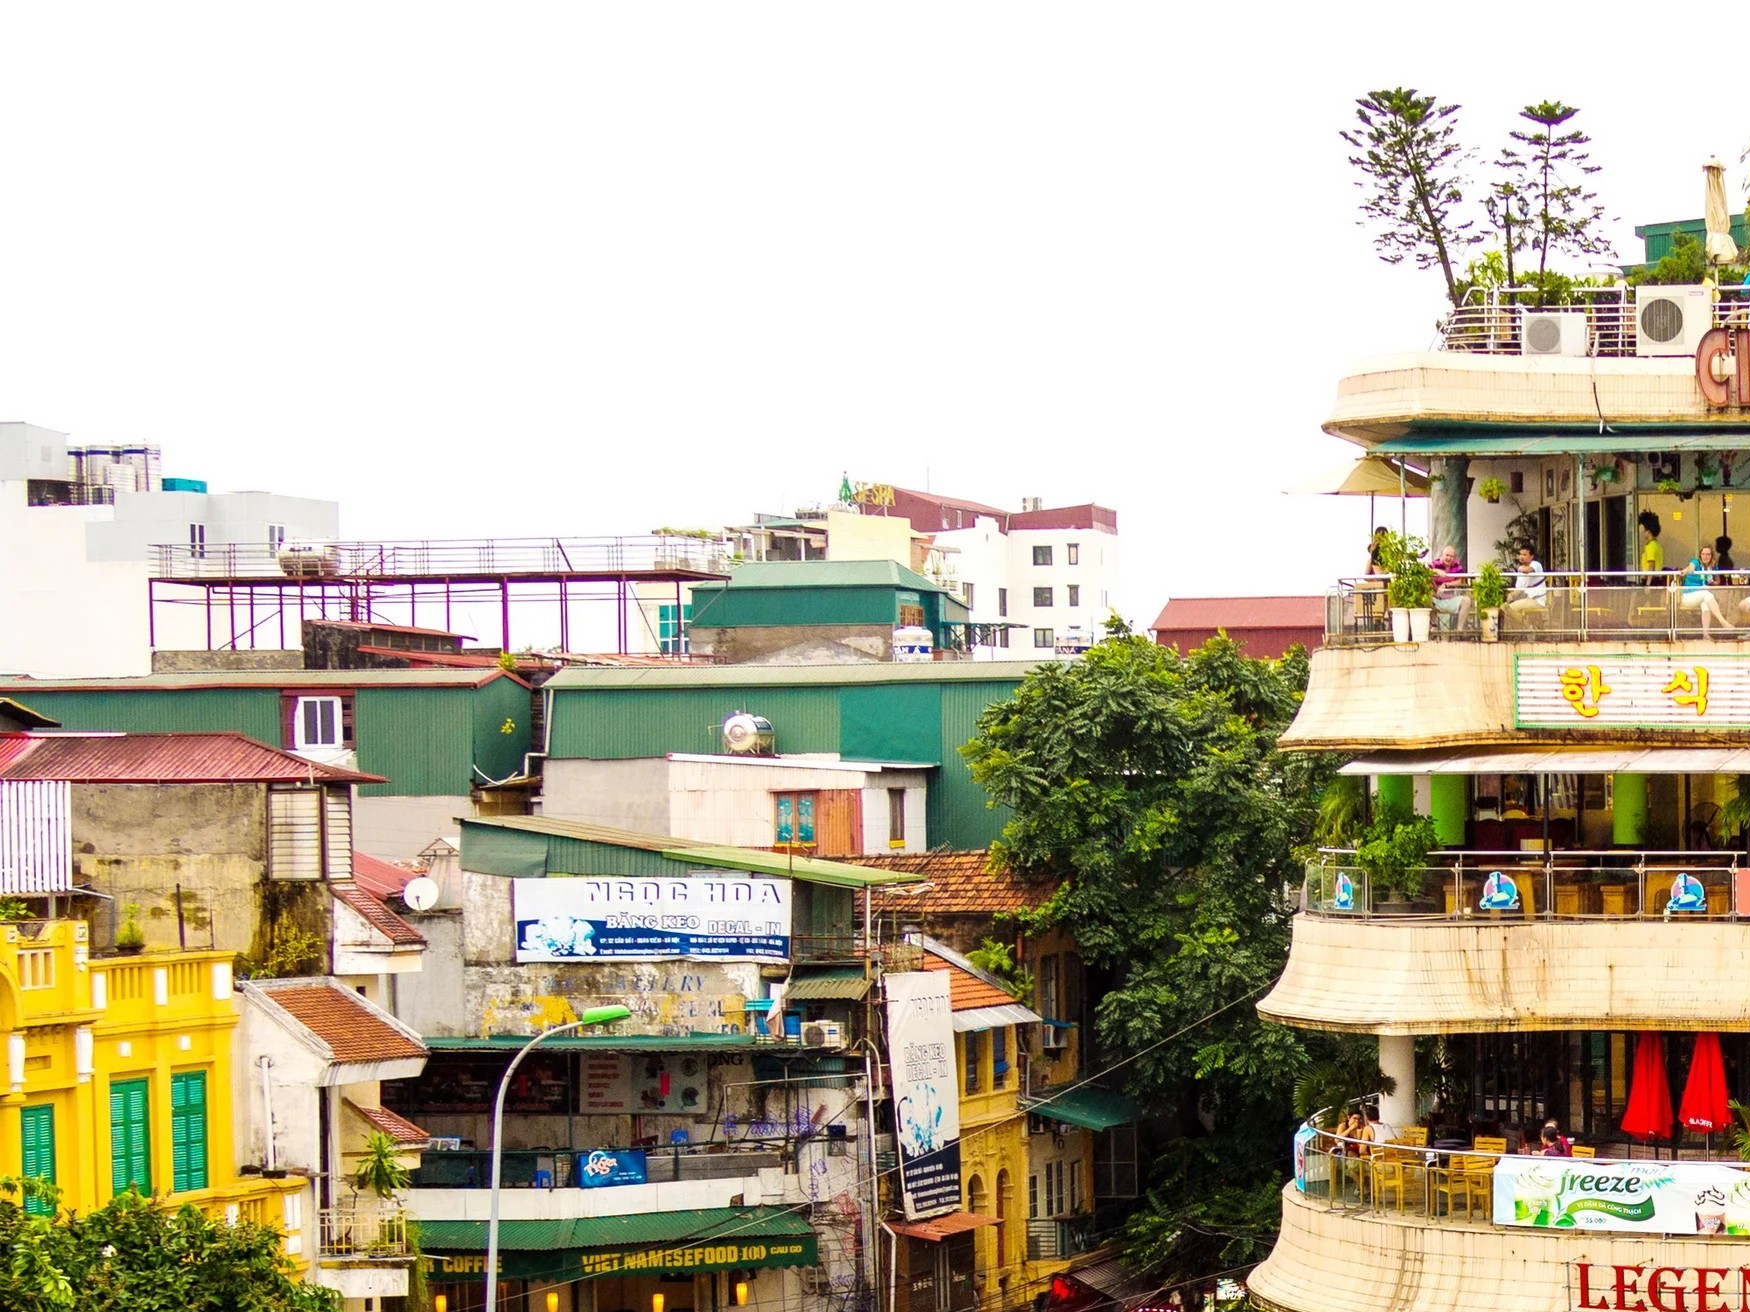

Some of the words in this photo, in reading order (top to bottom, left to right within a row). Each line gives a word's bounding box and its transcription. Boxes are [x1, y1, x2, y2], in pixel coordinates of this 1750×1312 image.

[606, 912, 659, 930] BĂNG
[661, 914, 700, 930] KEO
[708, 919, 752, 936] DECAL
[764, 921, 782, 936] IN
[1557, 1170, 1641, 1198] freeze
